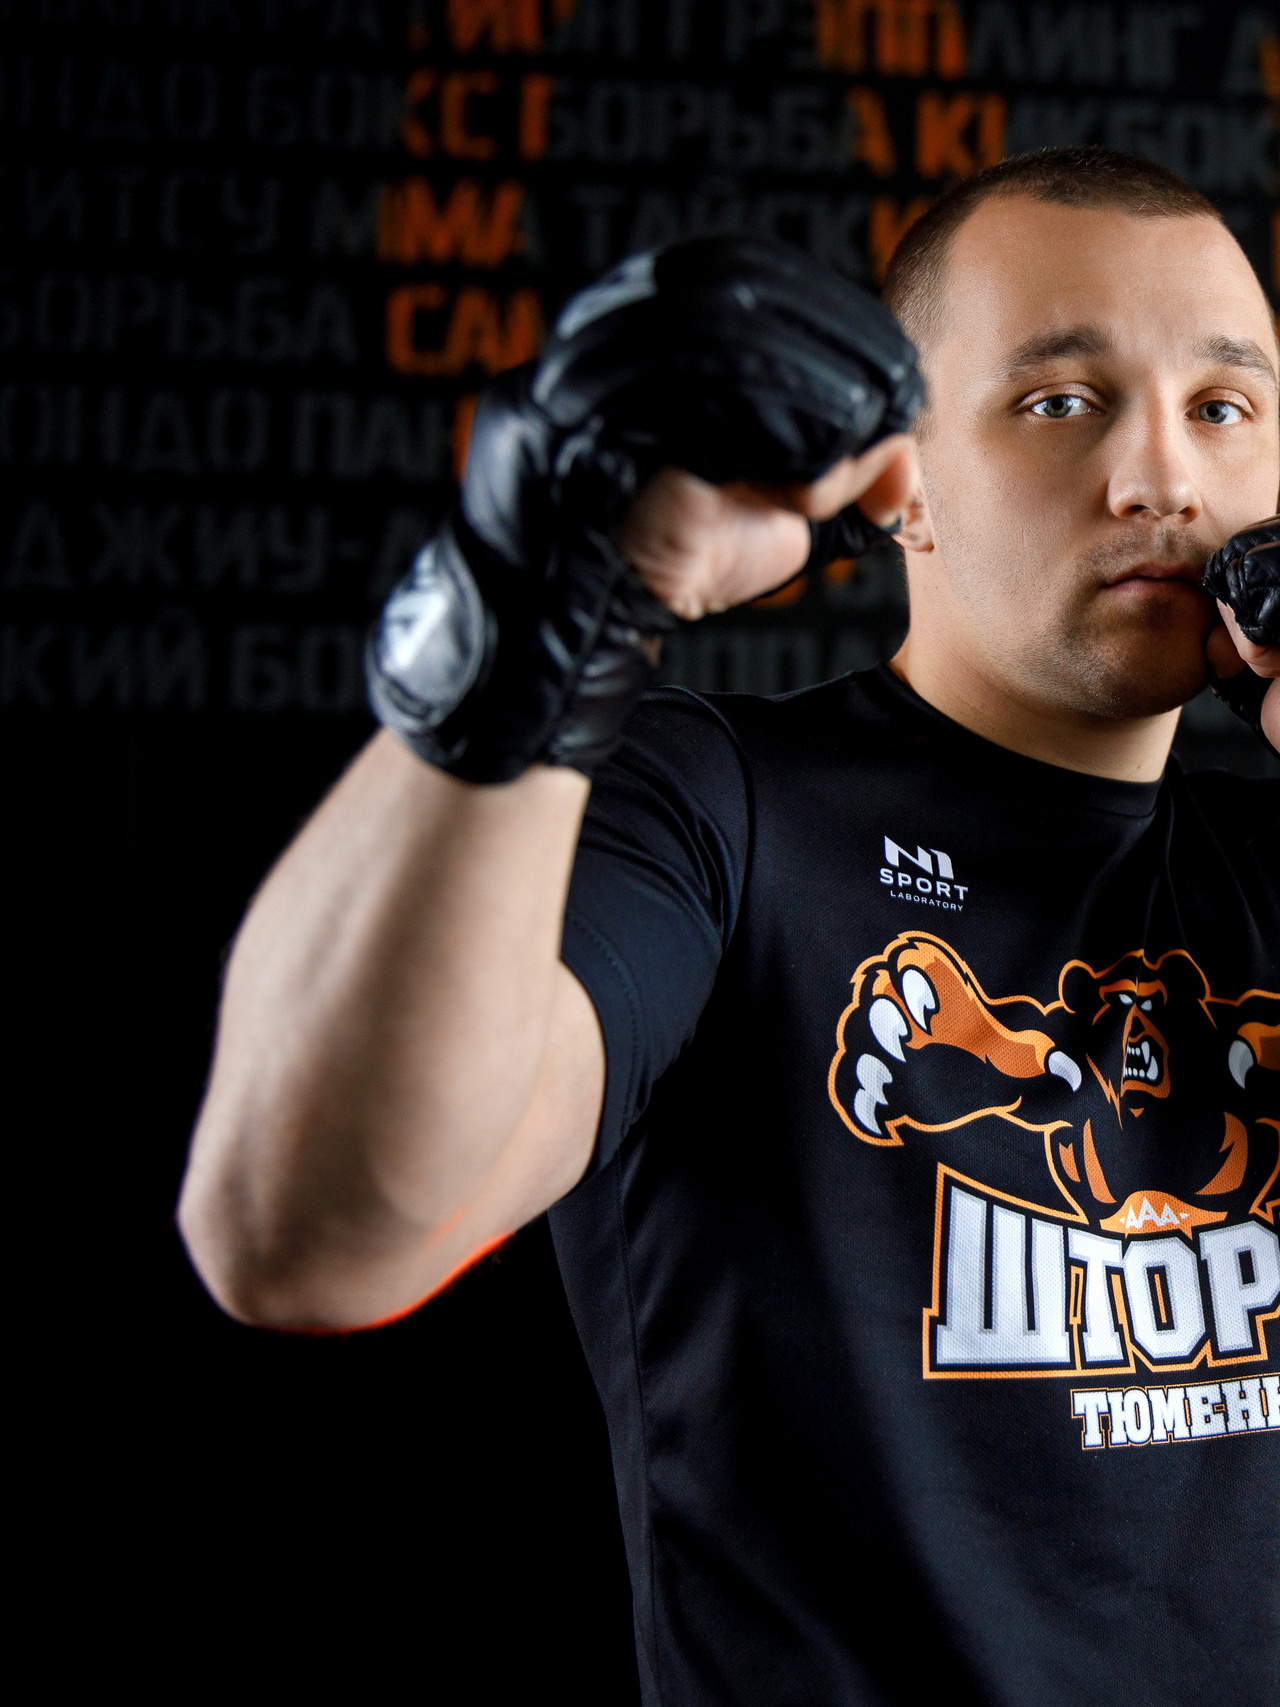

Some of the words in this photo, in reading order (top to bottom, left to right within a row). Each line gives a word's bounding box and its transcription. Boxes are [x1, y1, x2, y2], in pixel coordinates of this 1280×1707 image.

[244, 62, 502, 164] БОКС
[518, 70, 898, 180] БОРЬБА
[308, 174, 548, 270] ММА
[879, 866, 969, 901] SPORT
[889, 889, 964, 912] LABORATORY
